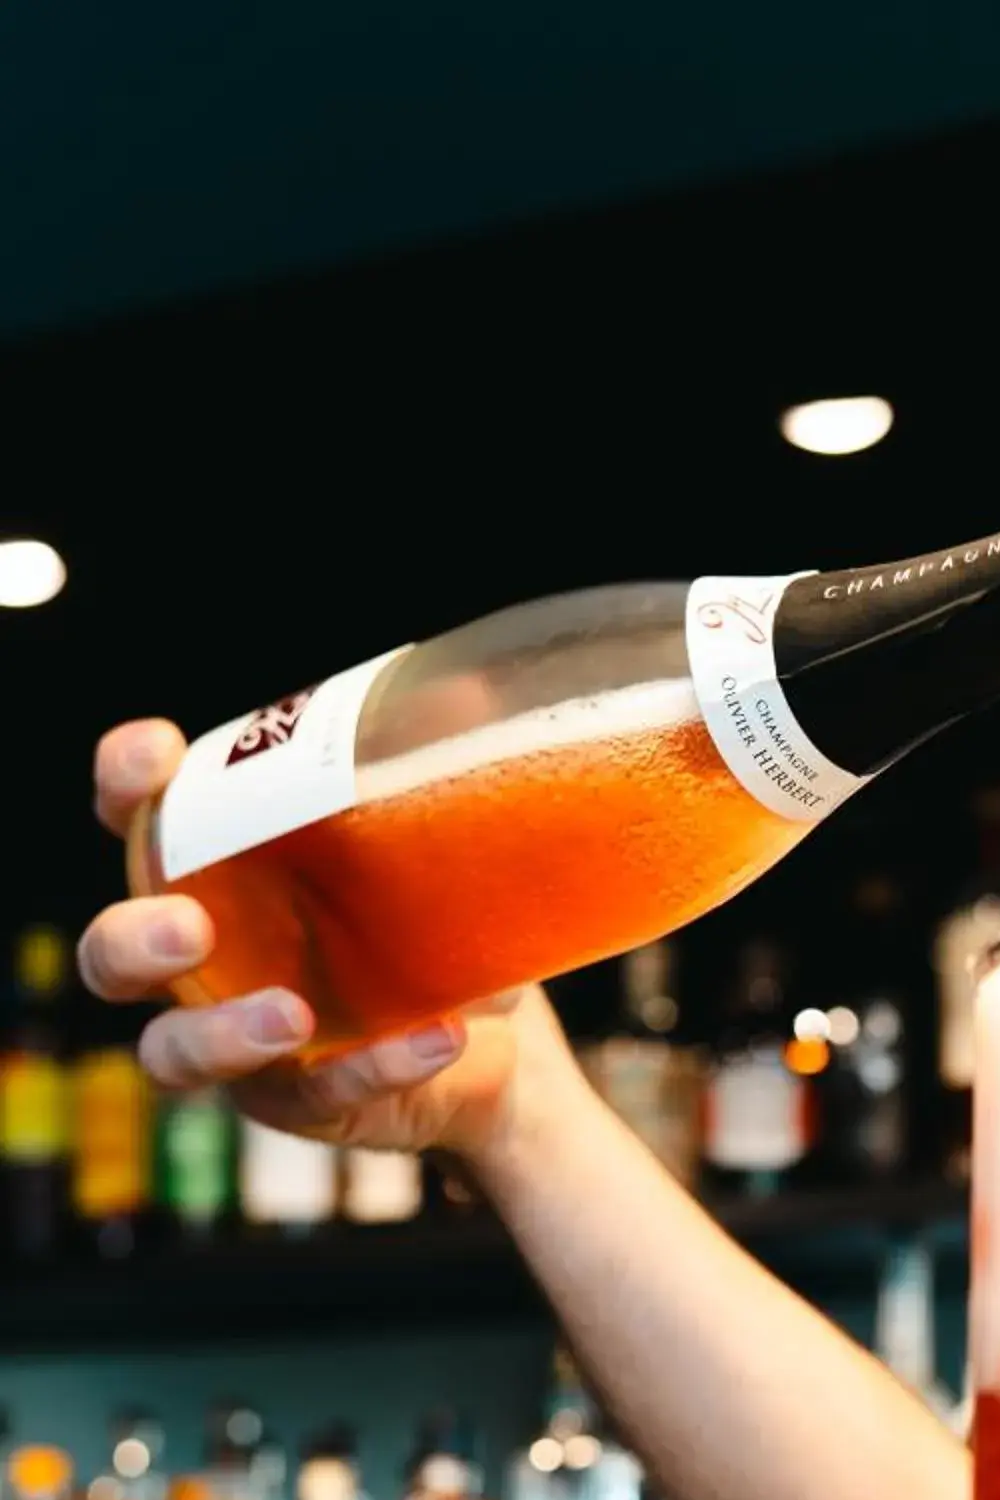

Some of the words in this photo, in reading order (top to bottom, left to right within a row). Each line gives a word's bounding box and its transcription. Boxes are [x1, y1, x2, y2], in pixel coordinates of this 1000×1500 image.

[721, 674, 757, 750] OLIVIER
[752, 747, 825, 808] HERBERT
[755, 697, 820, 783] CHAMPAGNE
